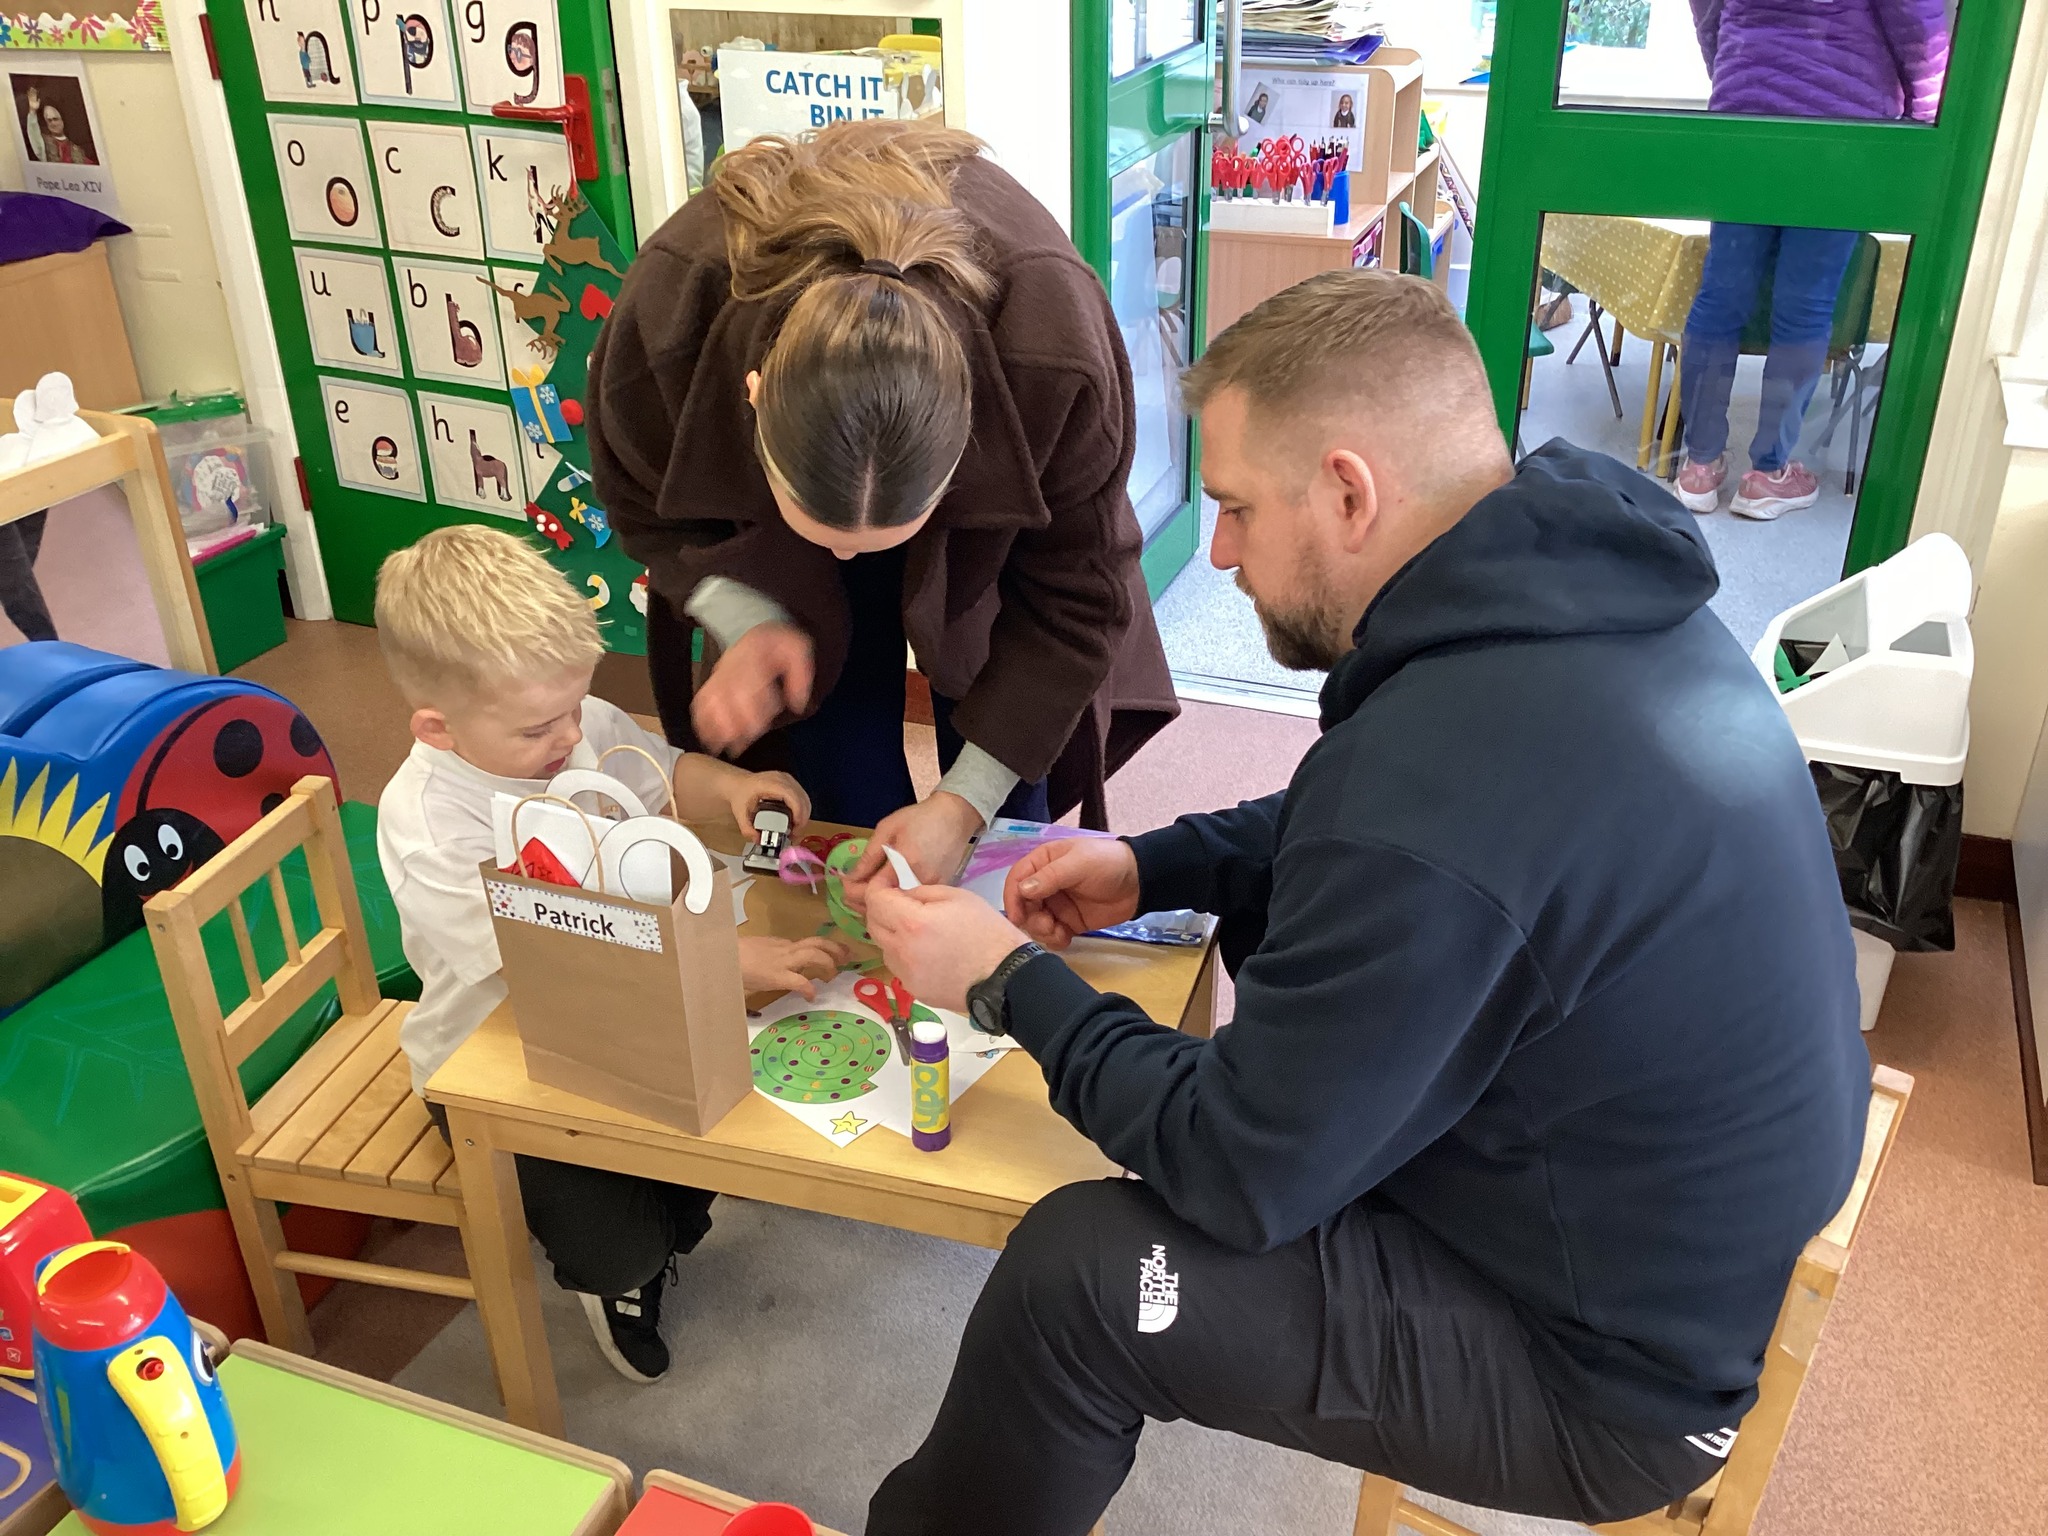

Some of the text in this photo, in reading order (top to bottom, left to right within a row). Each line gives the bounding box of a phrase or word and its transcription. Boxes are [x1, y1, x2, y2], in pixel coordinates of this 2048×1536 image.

[361, 0, 381, 36] p
[466, 0, 486, 44] g
[396, 13, 434, 95] p
[505, 20, 540, 106] g
[765, 69, 883, 101] CATCH IT
[810, 104, 852, 128] BIN
[287, 139, 305, 167] o
[385, 146, 402, 174] c
[486, 138, 508, 182] k
[36, 176, 102, 193] Pope Leo XIV
[325, 176, 359, 227] o
[430, 185, 461, 238] c
[310, 270, 332, 296] u
[407, 269, 428, 308] b
[445, 293, 483, 368] b
[335, 400, 350, 423] e
[431, 404, 455, 443] h
[371, 436, 400, 480] e
[533, 902, 616, 938] Patrick
[1139, 1257, 1153, 1303] FACE
[1152, 1244, 1166, 1304] NORTH
[1165, 1272, 1179, 1305] THE
